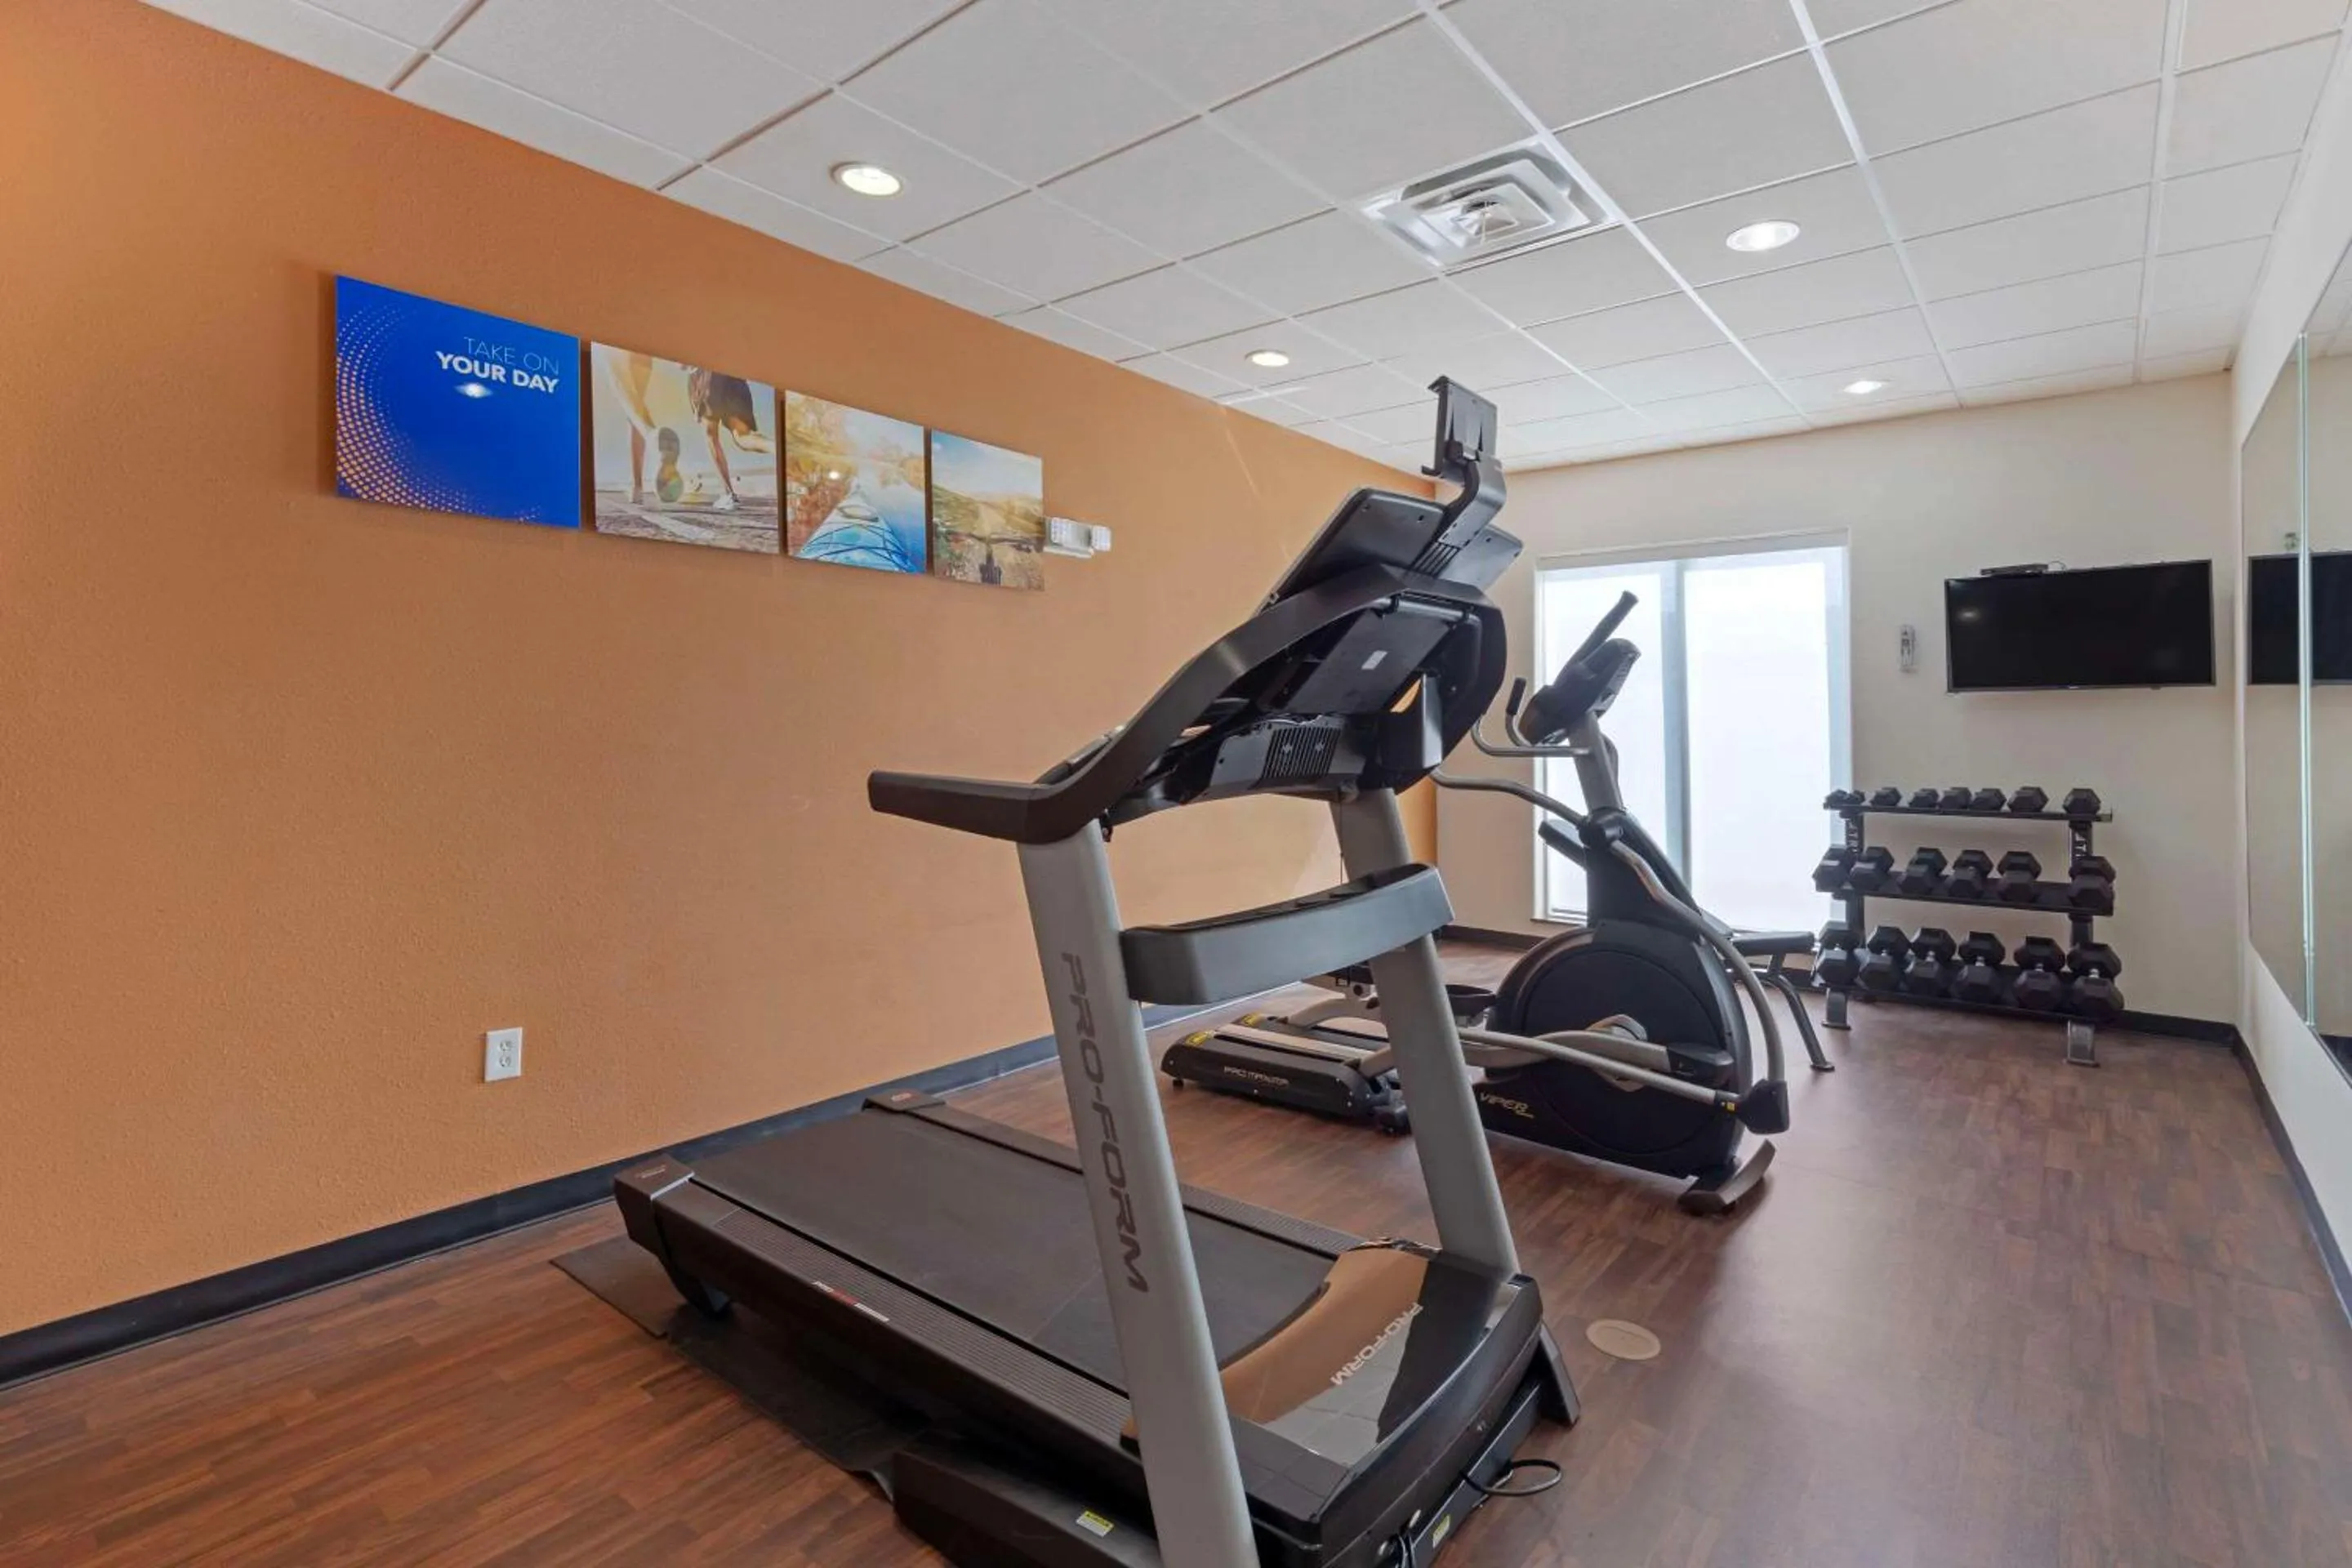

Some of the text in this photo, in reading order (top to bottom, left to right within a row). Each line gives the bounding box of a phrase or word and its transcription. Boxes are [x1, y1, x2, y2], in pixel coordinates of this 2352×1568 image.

[435, 350, 559, 394] YOUR DAY
[463, 336, 559, 376] TAKE ON
[1062, 951, 1150, 1294] PRO-FORM
